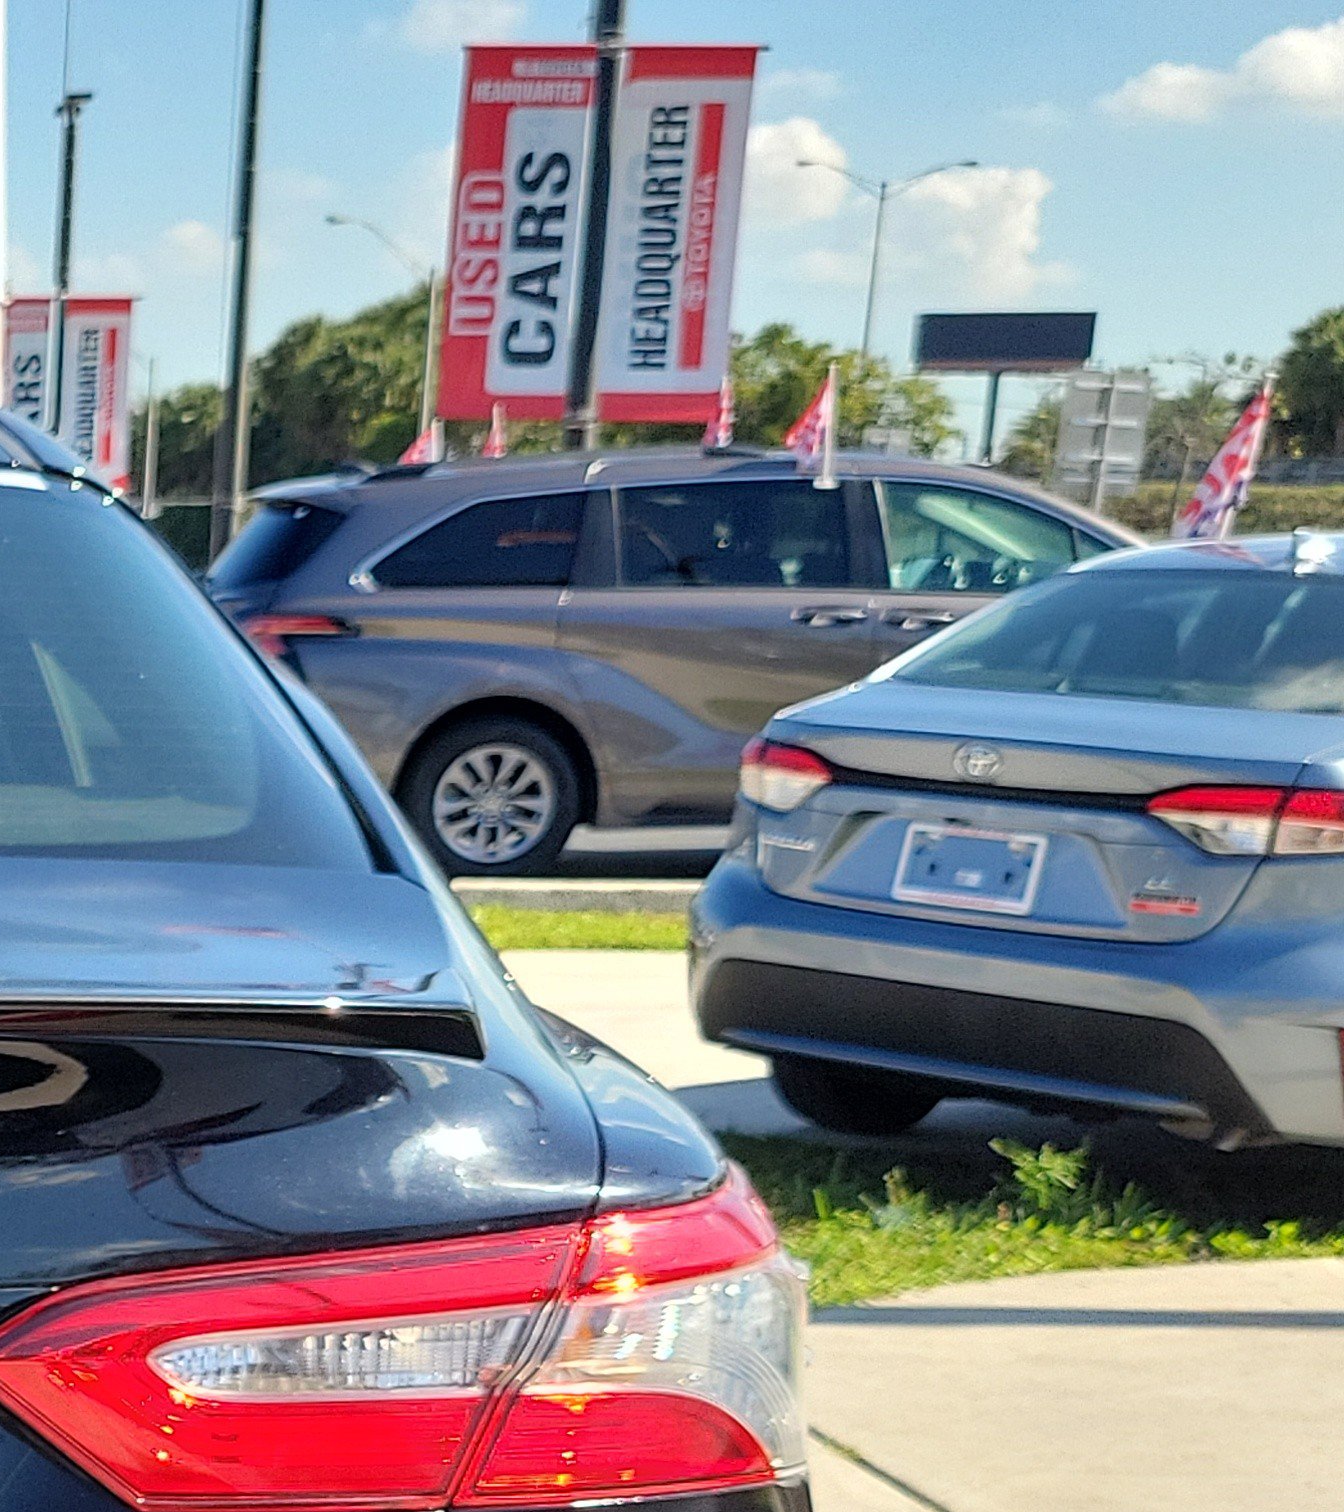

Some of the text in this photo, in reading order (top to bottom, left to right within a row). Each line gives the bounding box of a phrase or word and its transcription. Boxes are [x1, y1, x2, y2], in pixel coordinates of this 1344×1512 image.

[454, 177, 505, 328] USED
[501, 151, 572, 367] CARS
[626, 104, 691, 371] HEADQUARTER
[684, 172, 716, 275] TOYOTA
